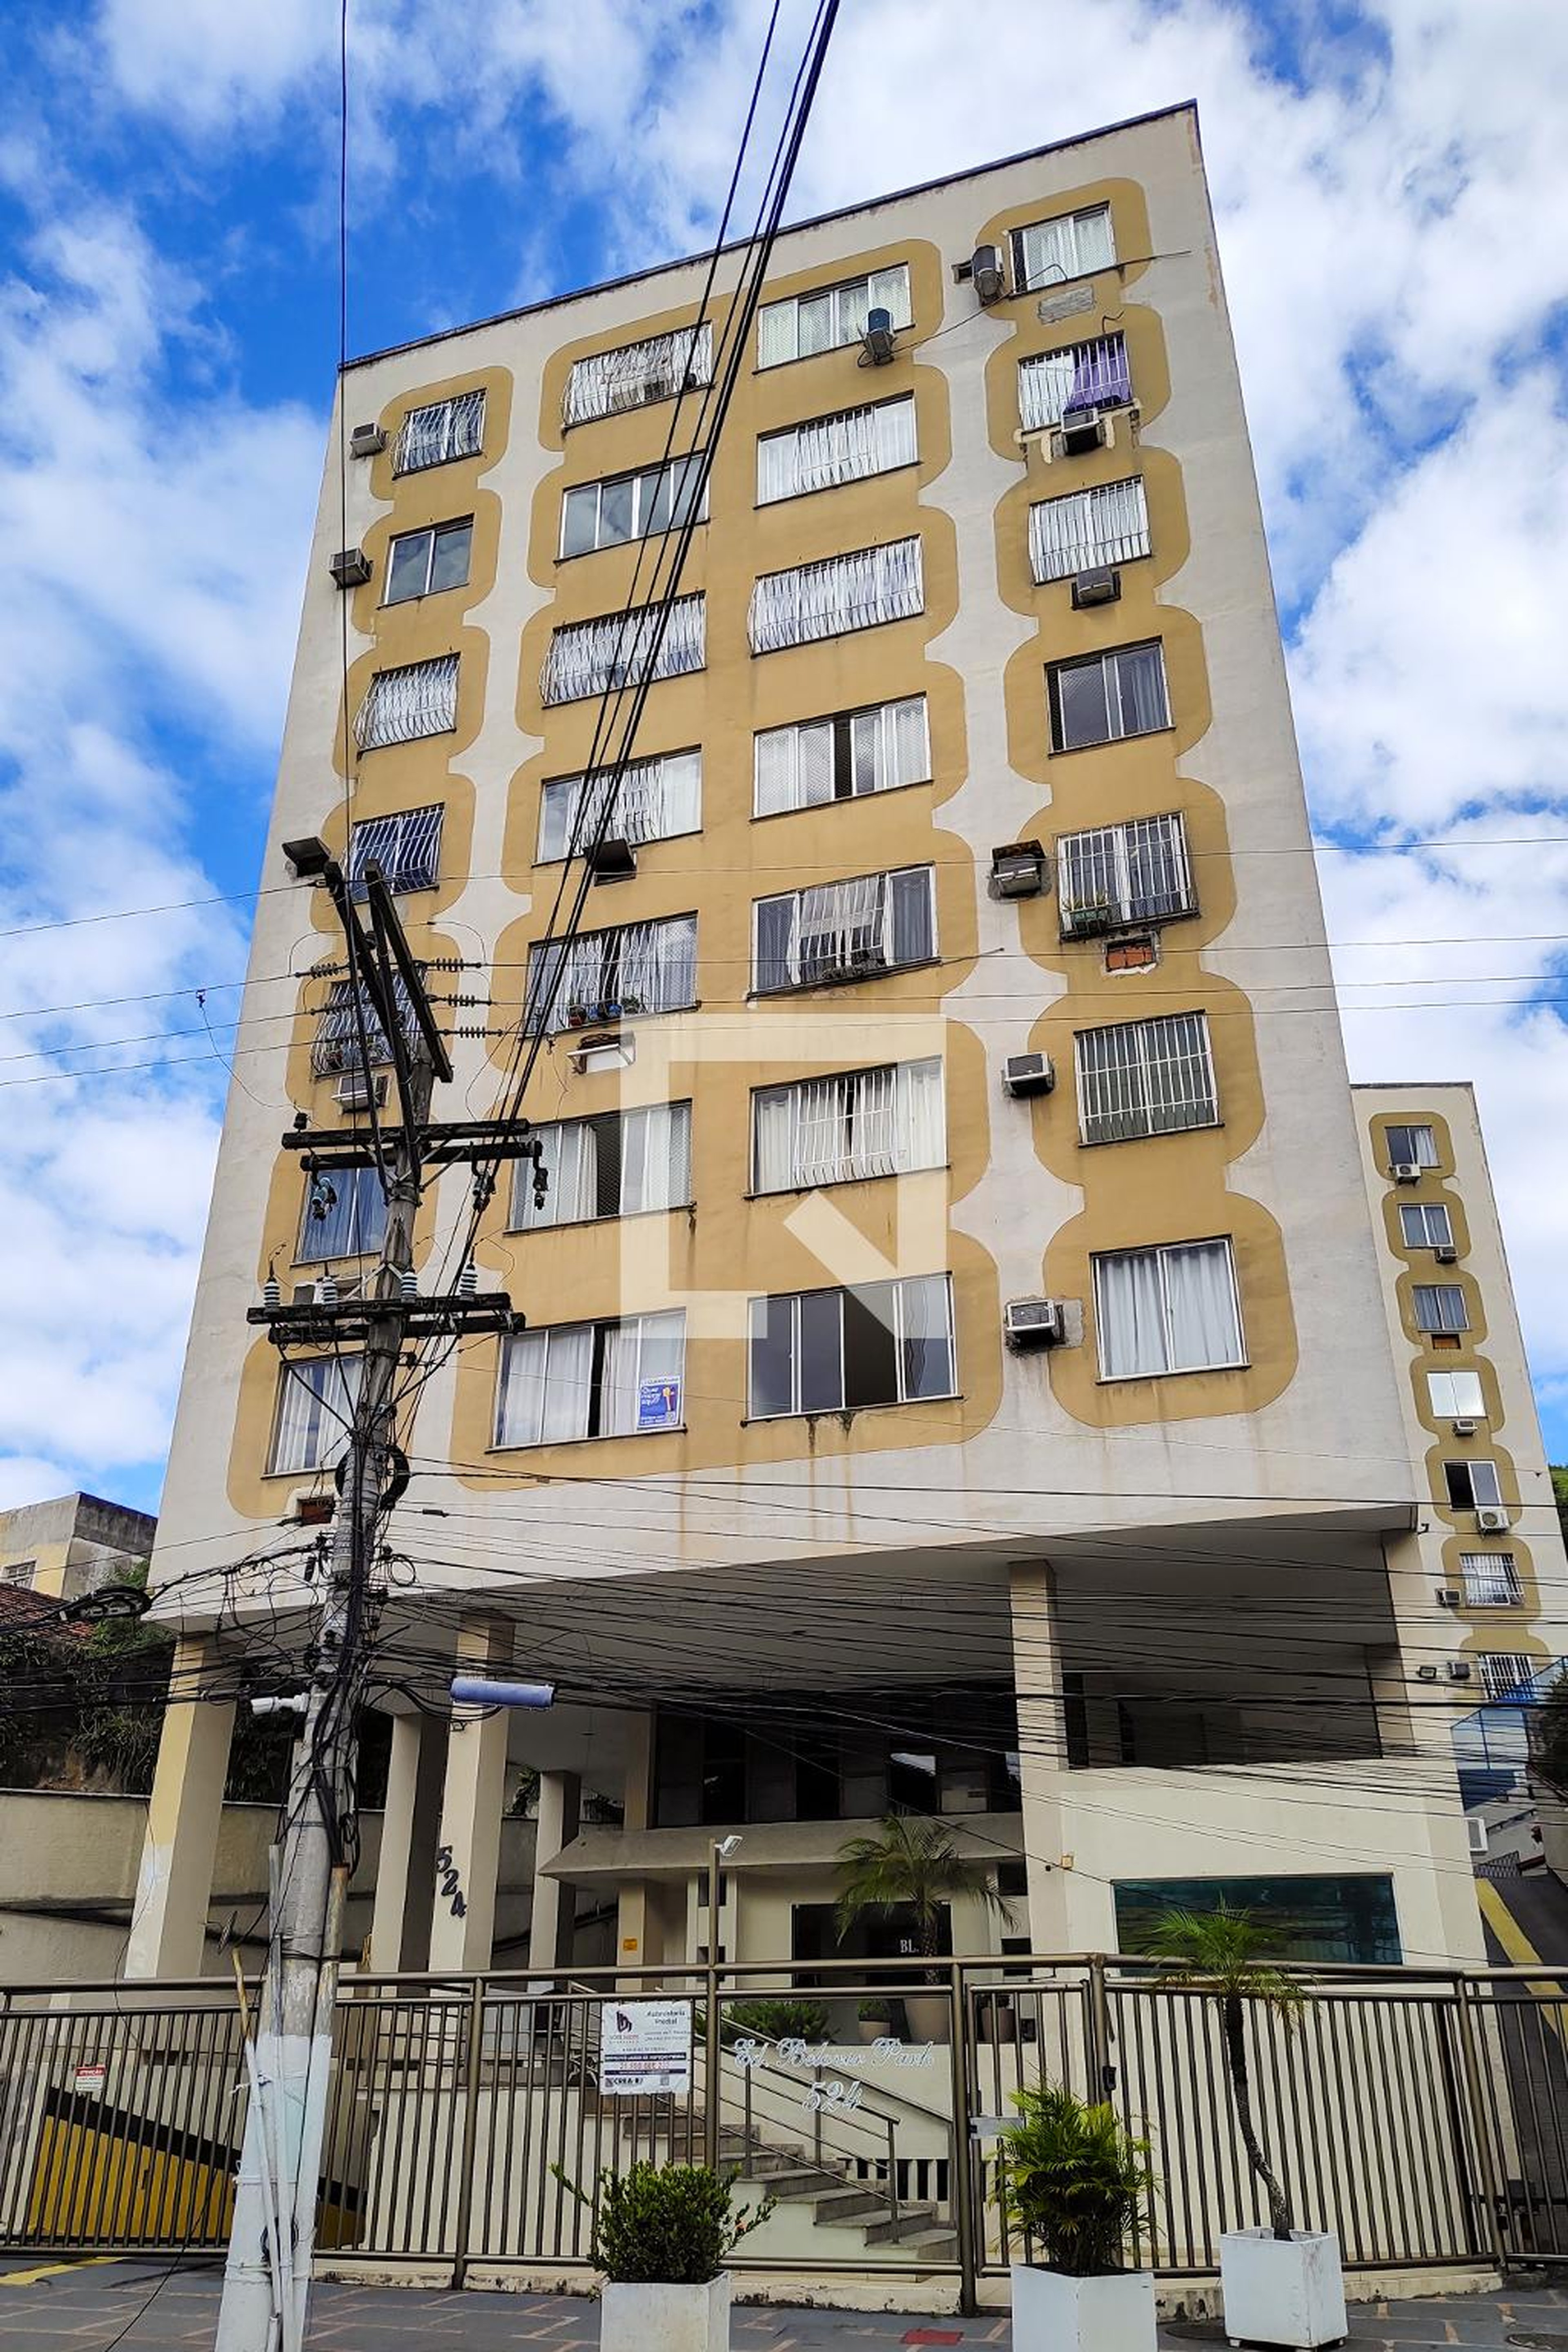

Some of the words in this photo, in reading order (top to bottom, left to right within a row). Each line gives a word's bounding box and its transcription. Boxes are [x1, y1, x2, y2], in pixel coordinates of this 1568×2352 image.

[436, 1845, 467, 1918] 524
[735, 2038, 768, 2067] Ed.
[871, 2037, 934, 2067] Park
[802, 2081, 863, 2112] 524
